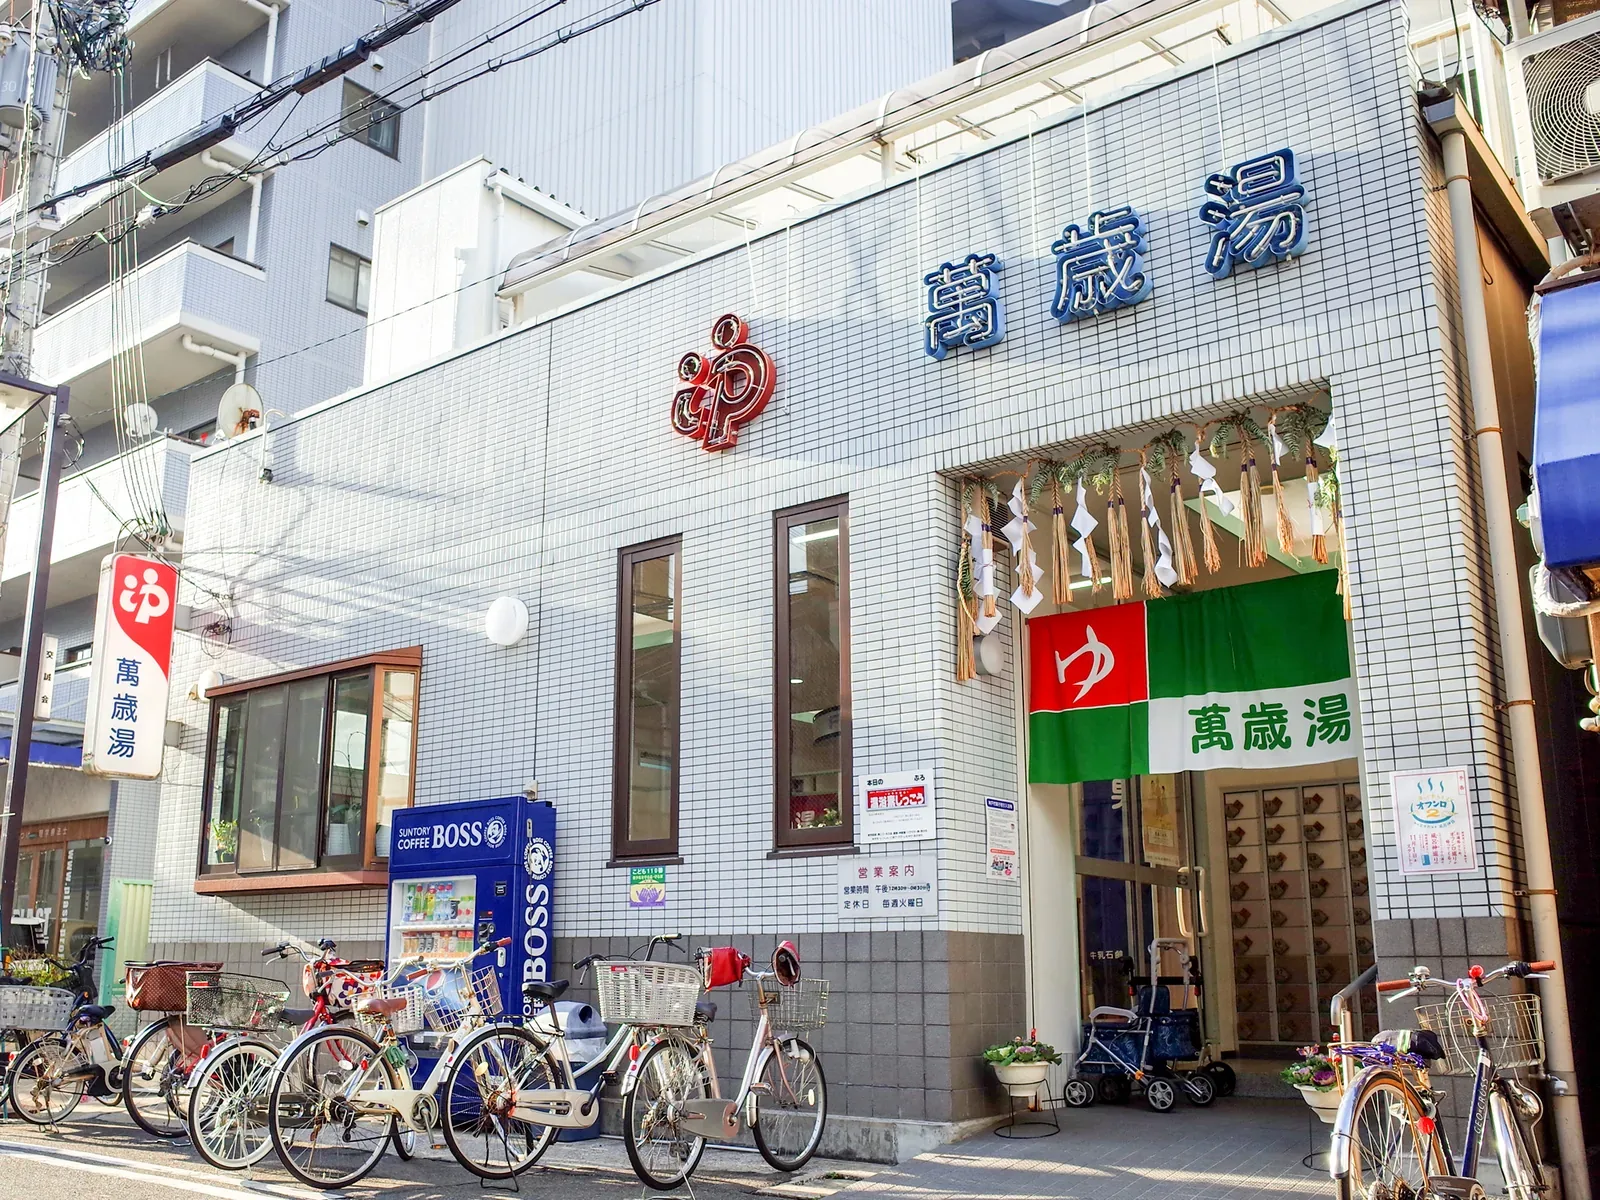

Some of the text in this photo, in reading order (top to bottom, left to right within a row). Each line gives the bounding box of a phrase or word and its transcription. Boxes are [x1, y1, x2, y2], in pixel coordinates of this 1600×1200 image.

[924, 147, 1312, 361] 萬歳湯
[1054, 623, 1115, 703] ゆ
[107, 657, 142, 758] 萬歳湯
[1187, 692, 1351, 754] 萬歳湯
[867, 778, 884, 786] 本日の
[1426, 808, 1440, 818] 2
[399, 826, 431, 837] SUNTORY
[431, 821, 482, 849] BOSS
[397, 837, 430, 850] COFFEE
[858, 864, 915, 879] 営業案内
[843, 885, 869, 895] 営業時間
[843, 898, 923, 909] 定休日 毎週火曜日
[523, 884, 549, 983] BOSS
